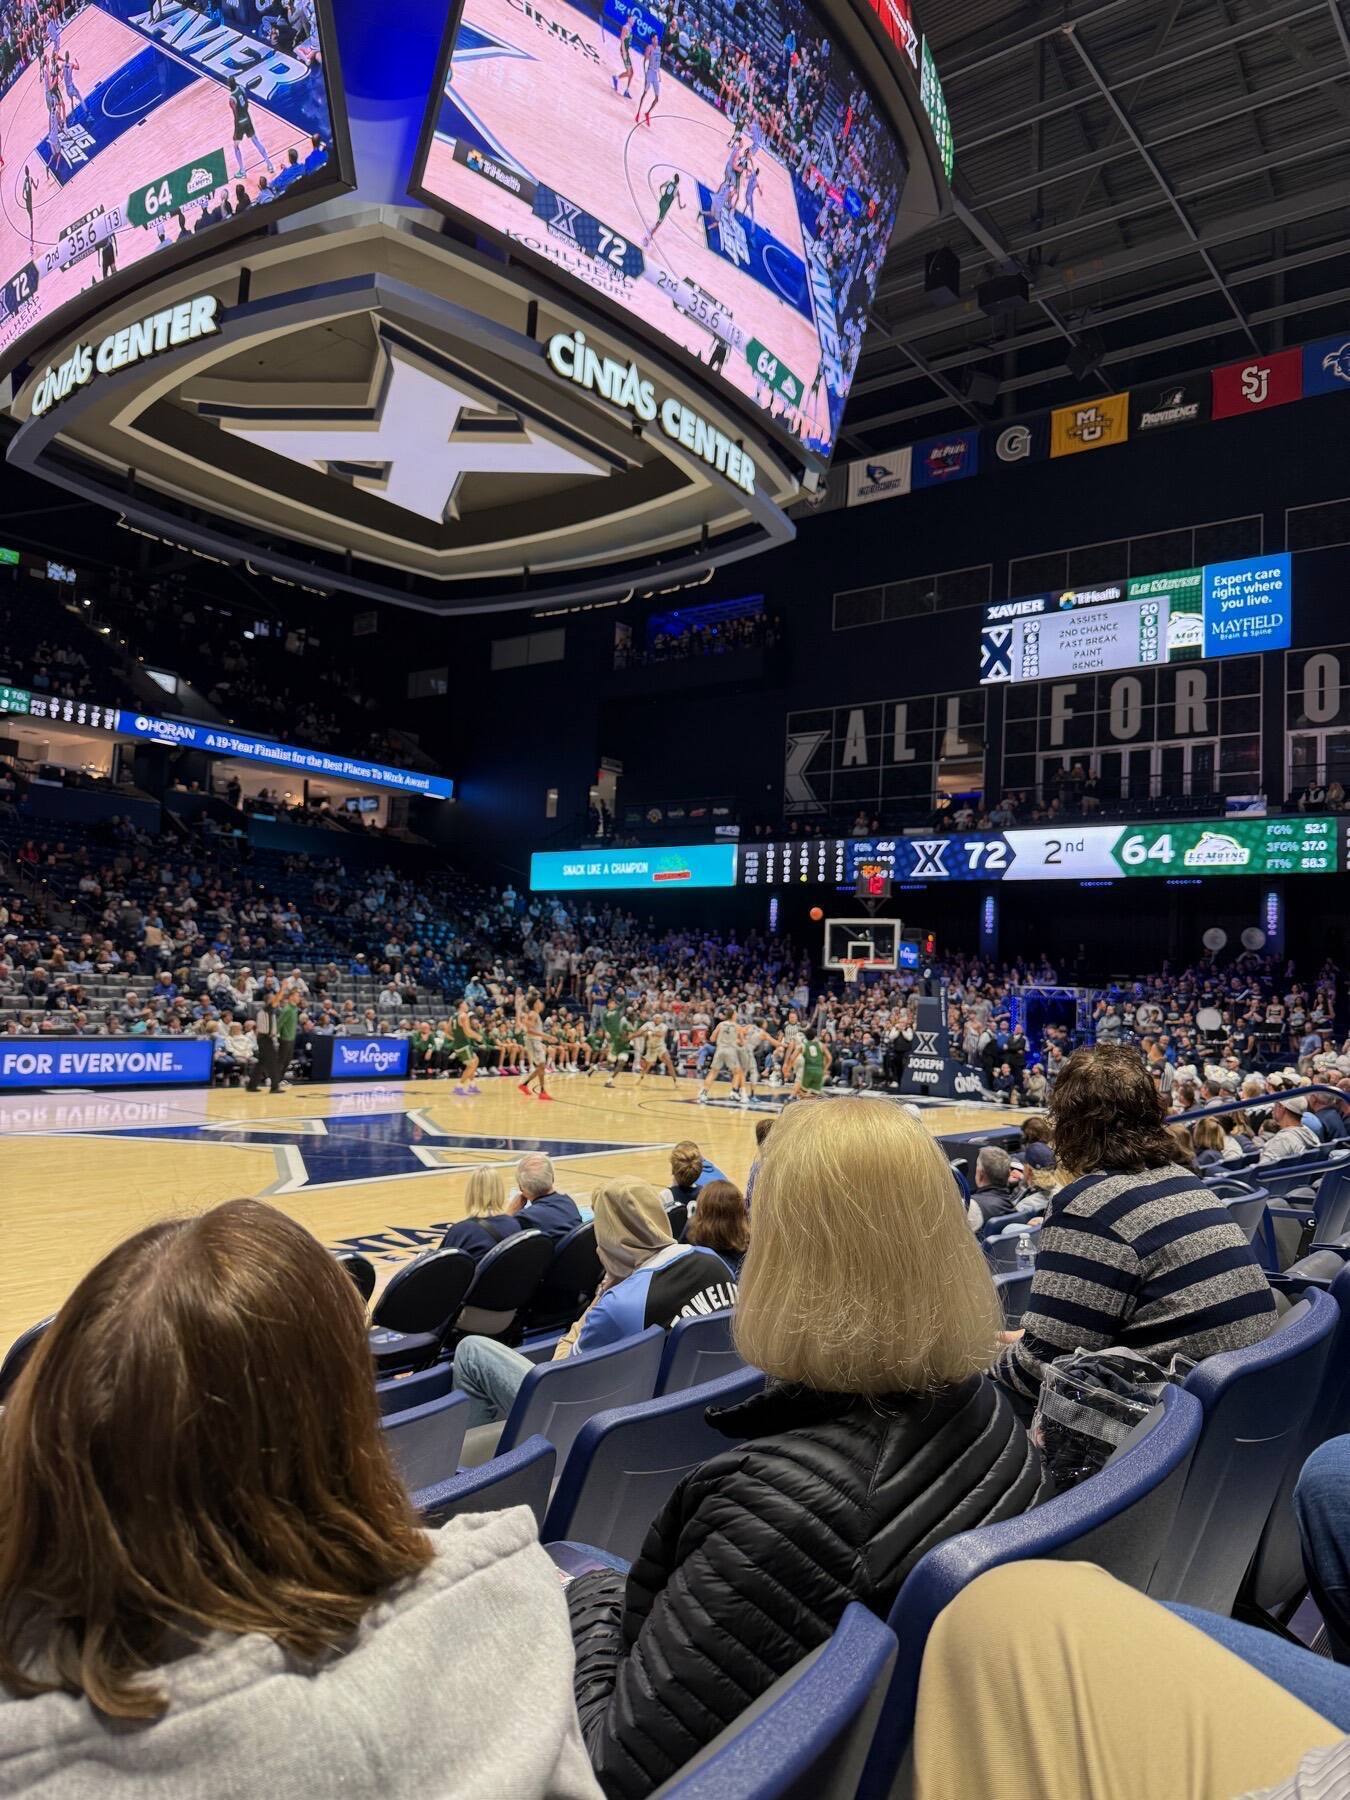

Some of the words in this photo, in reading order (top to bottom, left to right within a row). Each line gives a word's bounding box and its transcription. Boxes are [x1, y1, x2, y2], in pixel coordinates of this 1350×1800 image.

[145, 180, 172, 215] 64
[45, 247, 60, 272] 2nd
[68, 223, 97, 256] 35.6
[107, 211, 120, 230] 13
[598, 226, 627, 266] 72
[12, 272, 30, 302] 72
[688, 293, 719, 329] 35.6
[96, 294, 218, 373] CENTER
[757, 351, 778, 381] 64
[661, 398, 757, 496] CENTER
[1214, 572, 1253, 589] Expert
[1255, 568, 1281, 580] care
[1212, 585, 1241, 600] right
[1244, 580, 1283, 594] where
[987, 599, 1046, 620] XAVIER
[1221, 598, 1244, 612] you
[1247, 594, 1273, 607] live.
[1022, 621, 1040, 634] 20
[1069, 613, 1109, 625] ASSISTS
[1139, 602, 1159, 615] 20
[1080, 622, 1119, 636] CHANCE
[1144, 615, 1154, 626] 0
[1211, 613, 1284, 635] MAYFIELD
[1024, 643, 1039, 655] 12
[1059, 639, 1082, 650] FAST
[1085, 635, 1118, 646] BREAK
[1141, 626, 1158, 638] 10
[1072, 659, 1104, 670] BENCH
[1140, 650, 1158, 662] 15
[1074, 648, 1103, 658] PAINT
[1050, 668, 1210, 746] FOR
[148, 722, 197, 740] HORAN
[842, 696, 969, 767] ALL
[205, 734, 216, 746] A
[255, 743, 292, 761] Finalist
[292, 751, 306, 765] for
[307, 754, 322, 768] the
[323, 758, 343, 772] Best
[344, 762, 371, 778] Places
[372, 768, 383, 780] To
[383, 770, 404, 784] Work
[404, 775, 430, 789] Award
[1266, 824, 1293, 835] FG%
[1304, 823, 1328, 834] 52.1
[964, 841, 1007, 870] 72
[1045, 836, 1085, 865] 2nd
[1120, 834, 1177, 865] 64
[1265, 841, 1300, 852] 3FG%
[1301, 840, 1328, 851] 37.0
[563, 864, 586, 877] SNACK
[587, 864, 602, 876] LIKE
[603, 863, 610, 875] A
[611, 862, 649, 875] CHAMPION
[1266, 858, 1293, 869] FT%
[3, 1053, 53, 1075] FOR
[59, 1052, 173, 1074] EVERYONE
[359, 1042, 401, 1072] Kroger
[908, 1057, 945, 1071] JOSEPH
[912, 1071, 940, 1084] AUTO
[1307, 1219, 1316, 1227] C
